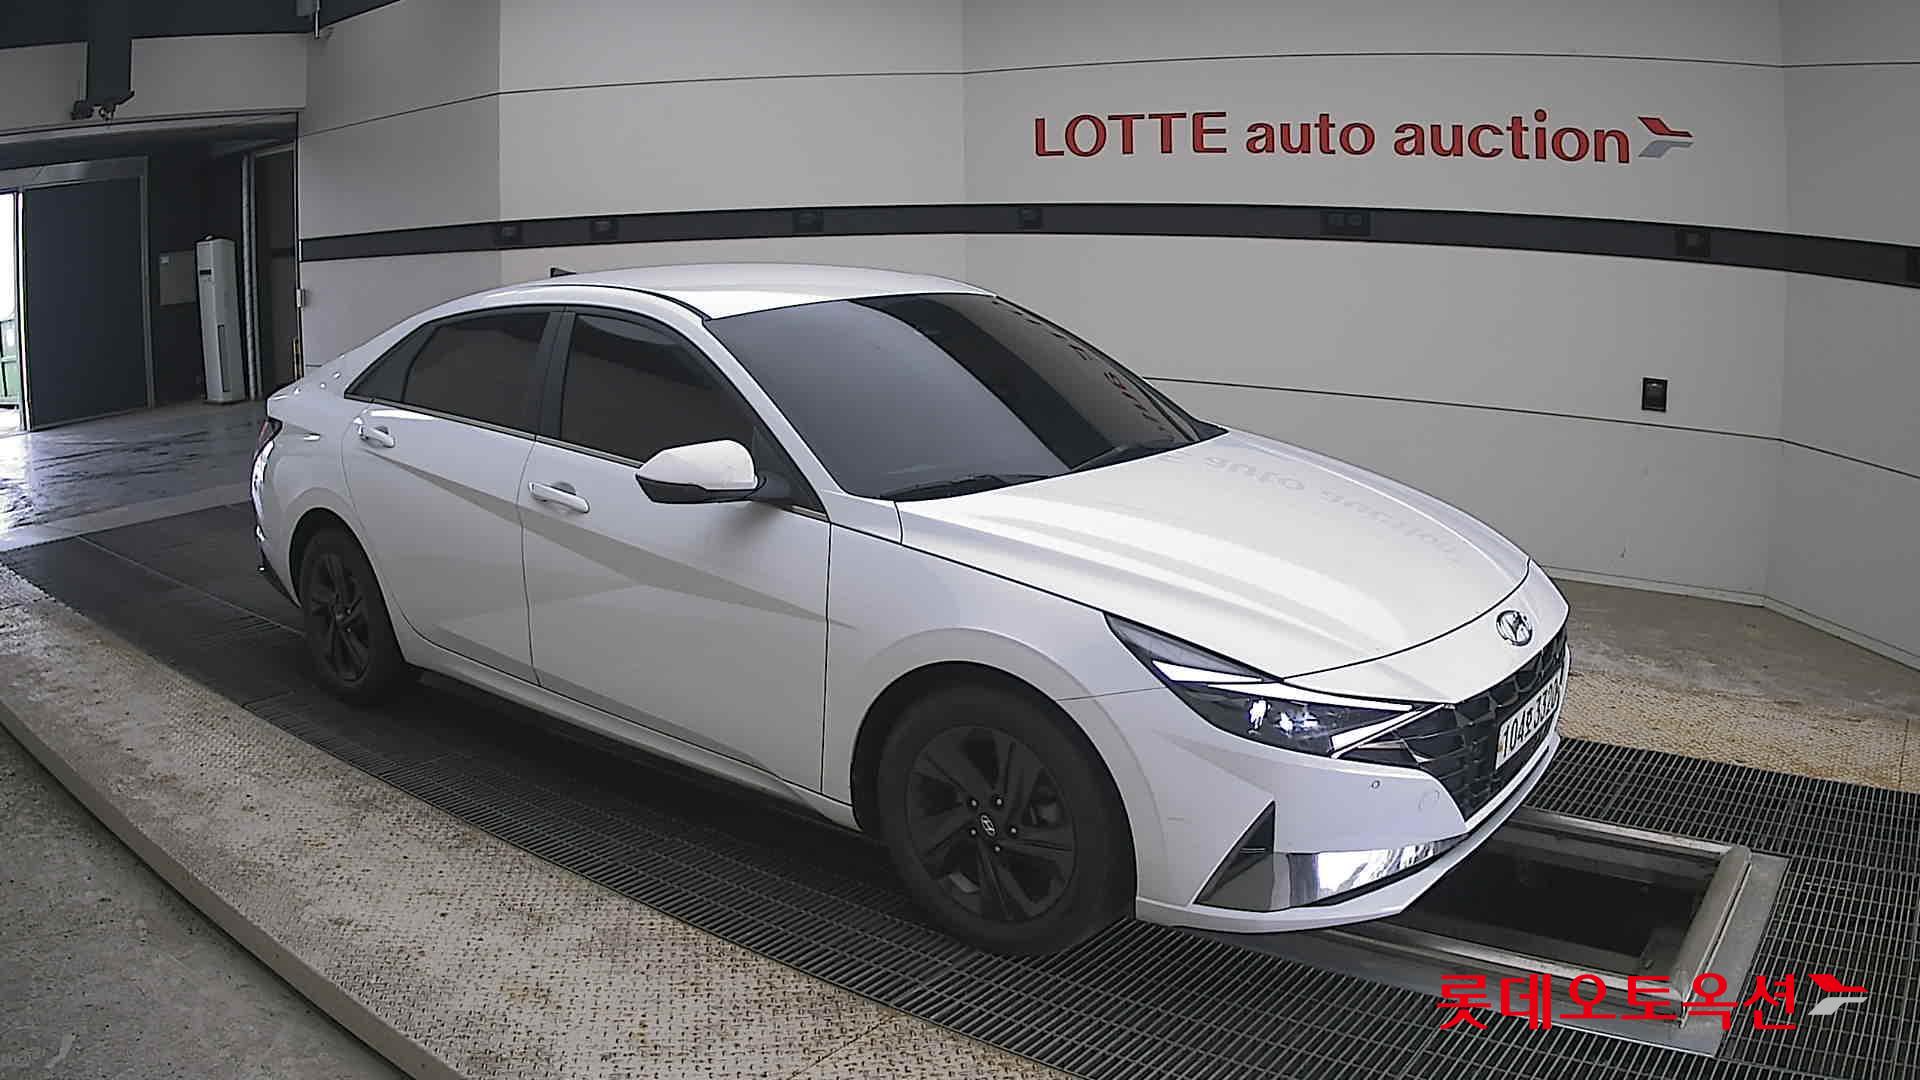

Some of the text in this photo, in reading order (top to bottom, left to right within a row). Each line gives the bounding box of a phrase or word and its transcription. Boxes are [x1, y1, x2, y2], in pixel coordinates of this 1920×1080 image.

[1034, 109, 1631, 163] LOTTE auto auction
